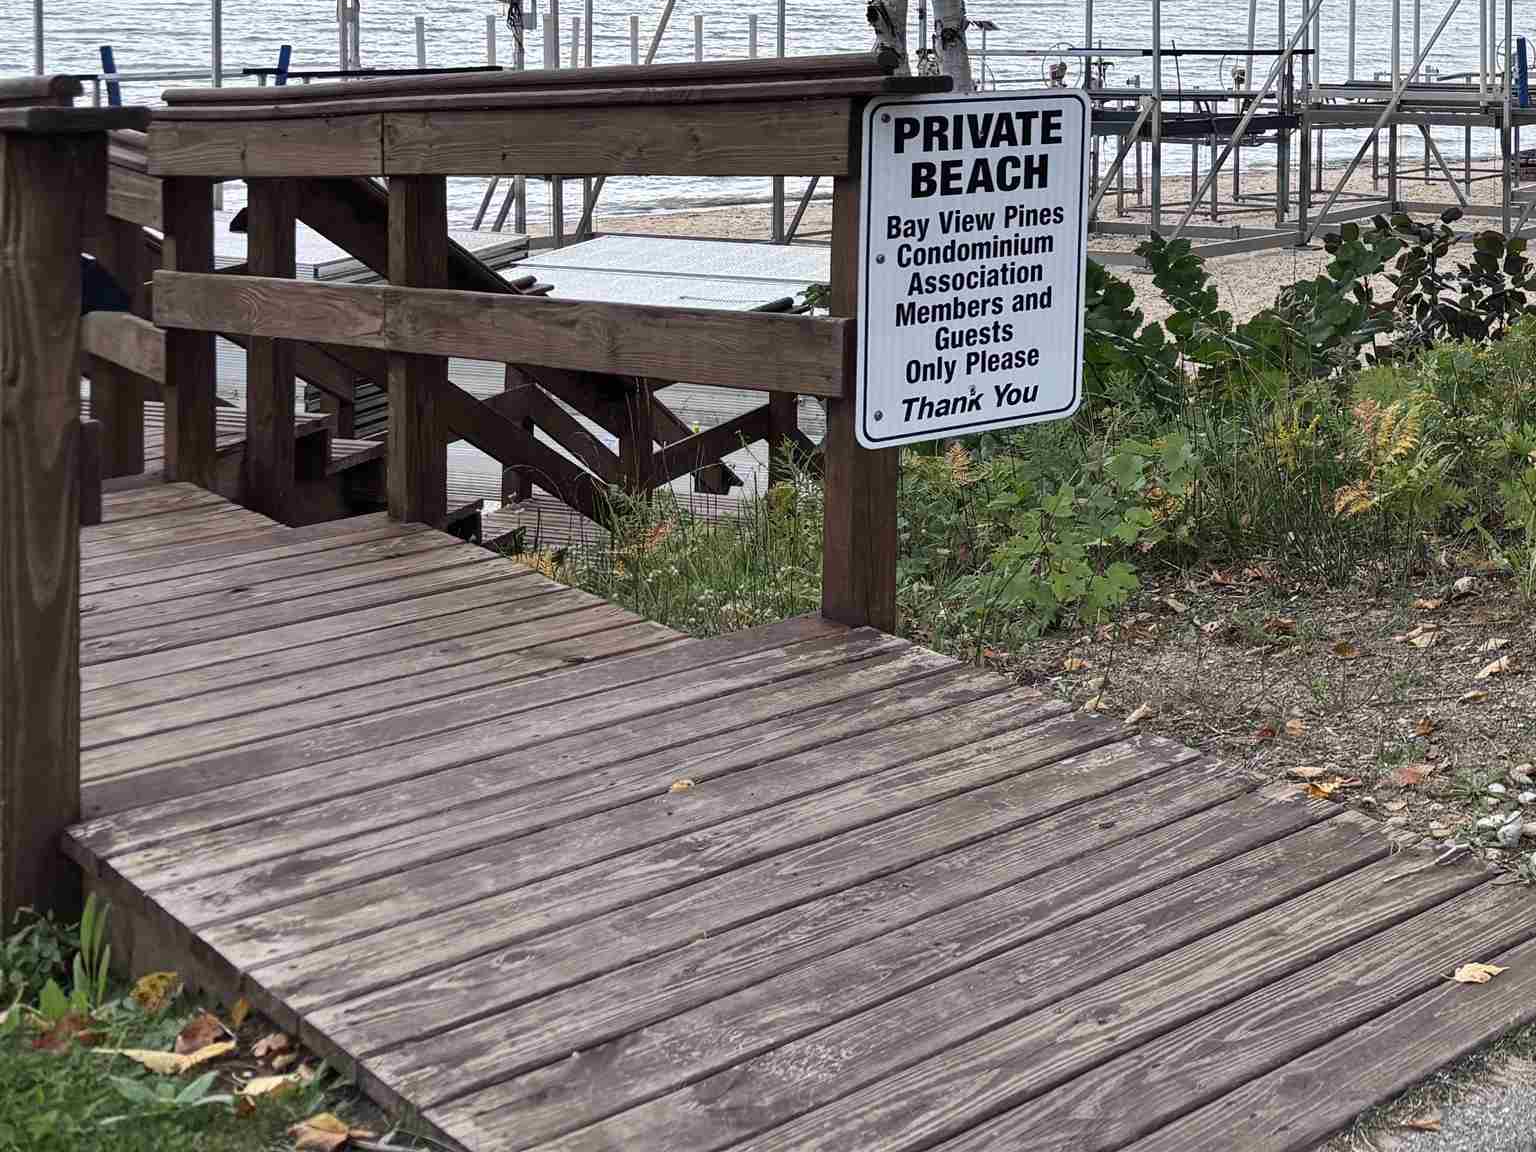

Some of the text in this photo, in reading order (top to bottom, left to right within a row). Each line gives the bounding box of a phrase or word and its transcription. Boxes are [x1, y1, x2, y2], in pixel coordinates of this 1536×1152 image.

[893, 109, 1062, 153] PRIVATE
[911, 154, 1048, 198] BEACH
[887, 204, 1064, 241] Bay View Pines
[897, 233, 1053, 268] Condominium
[908, 263, 1043, 296] Association
[895, 286, 1052, 327] Members and
[935, 321, 1013, 351] Guests
[906, 347, 1039, 385] Only Please
[902, 383, 1038, 422] Thank You
